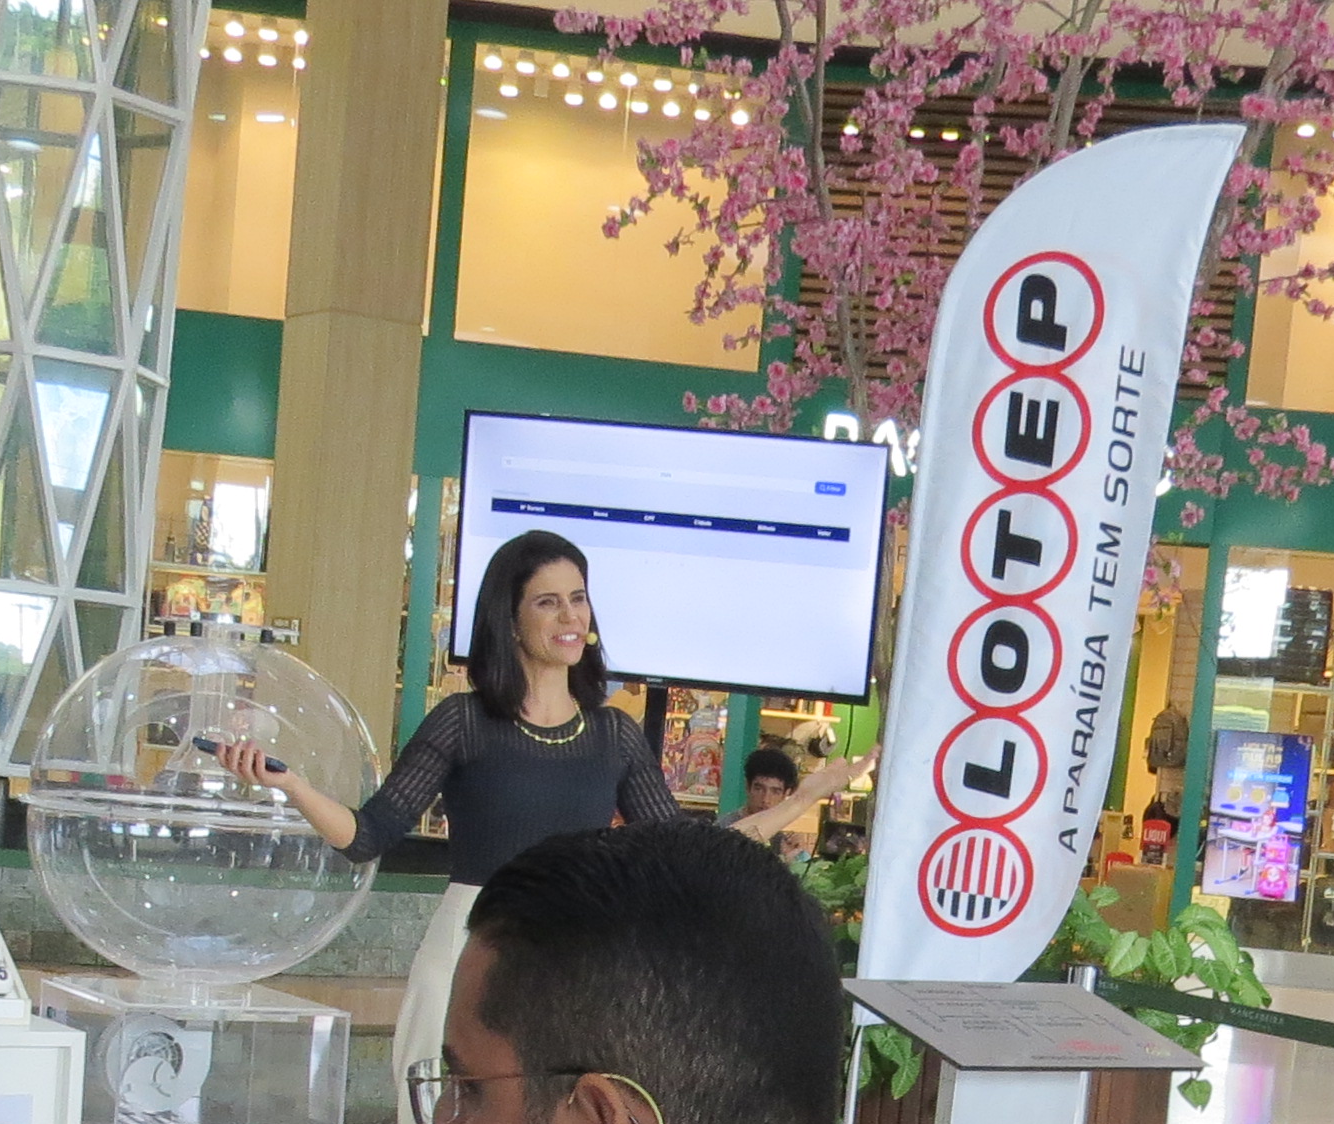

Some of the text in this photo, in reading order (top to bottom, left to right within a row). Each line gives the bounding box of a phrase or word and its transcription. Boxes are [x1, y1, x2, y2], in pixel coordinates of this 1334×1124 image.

[957, 268, 1075, 804] LOTEP
[1057, 345, 1146, 854] A PARAÍBA TEM SORTE
